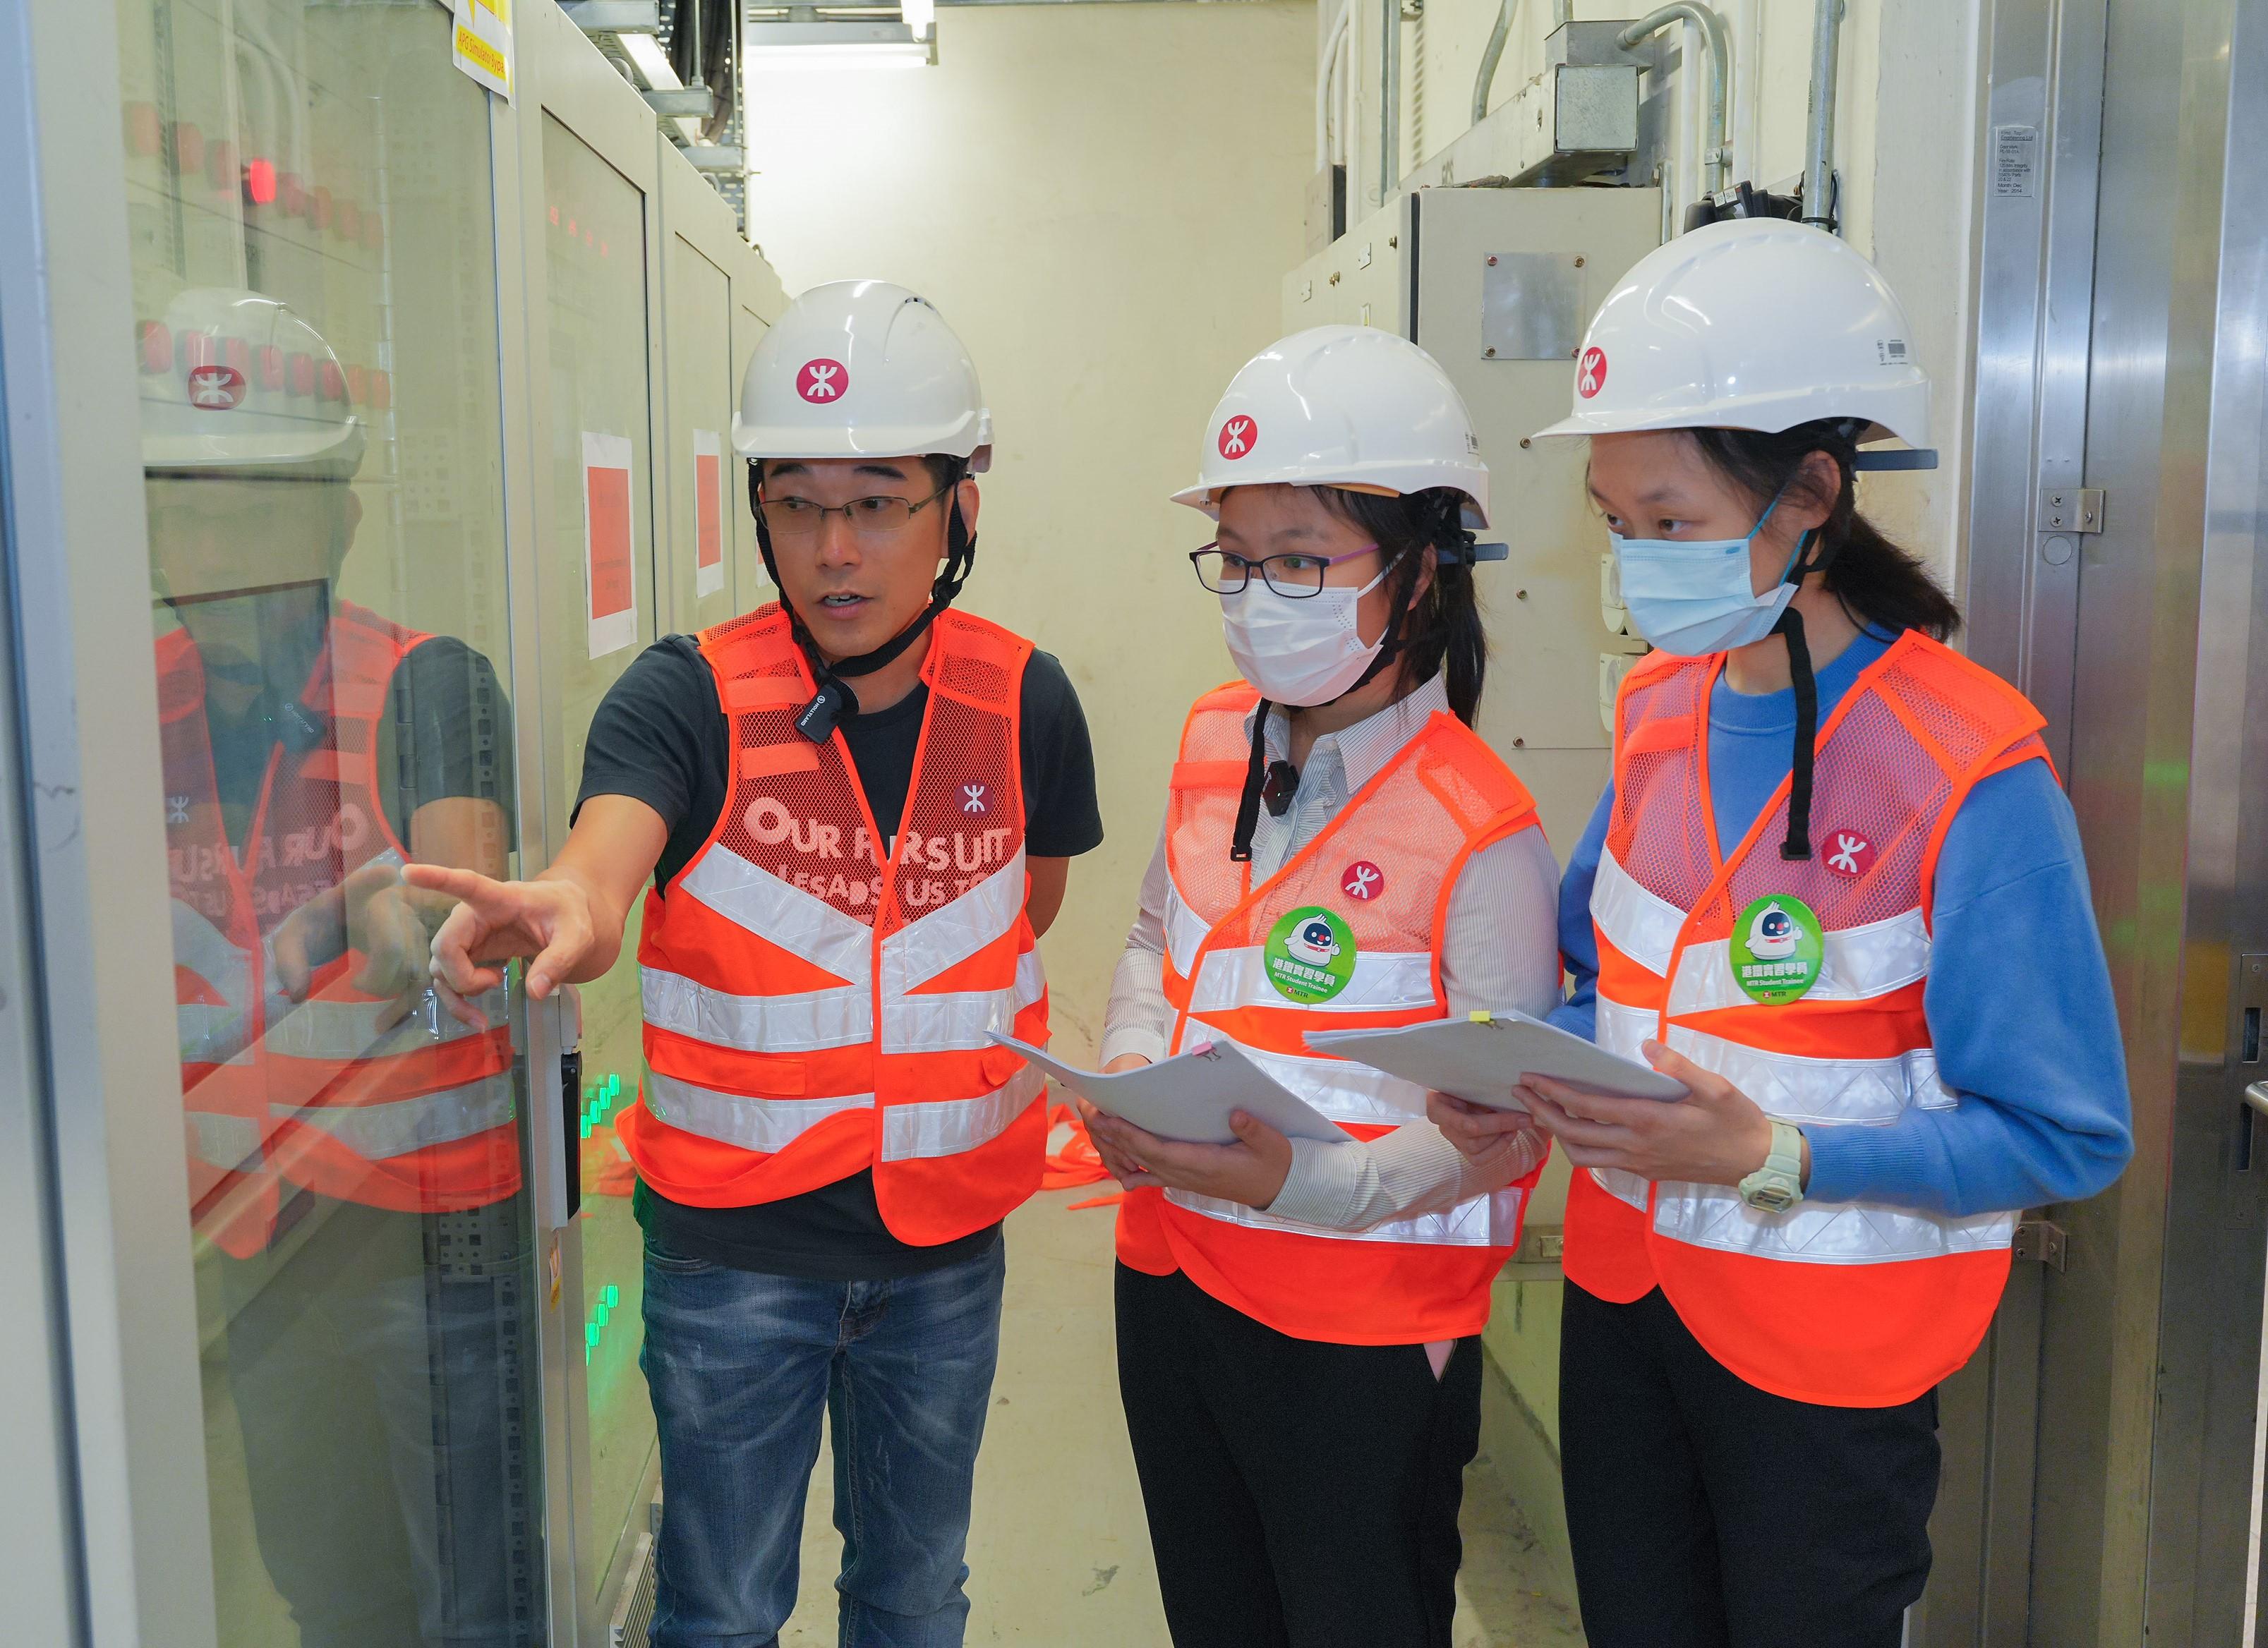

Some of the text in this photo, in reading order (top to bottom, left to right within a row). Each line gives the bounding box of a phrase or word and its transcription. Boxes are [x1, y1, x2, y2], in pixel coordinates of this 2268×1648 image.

[458, 31, 505, 74] APG Simulator Bypa
[800, 702, 820, 727] HOLLYLAND
[744, 796, 844, 859] OUR
[905, 879, 946, 907] US
[1272, 957, 1336, 987] 港鐵實習學員
[1274, 971, 1328, 993] MTR Student Trainee
[1293, 989, 1309, 998] MTR
